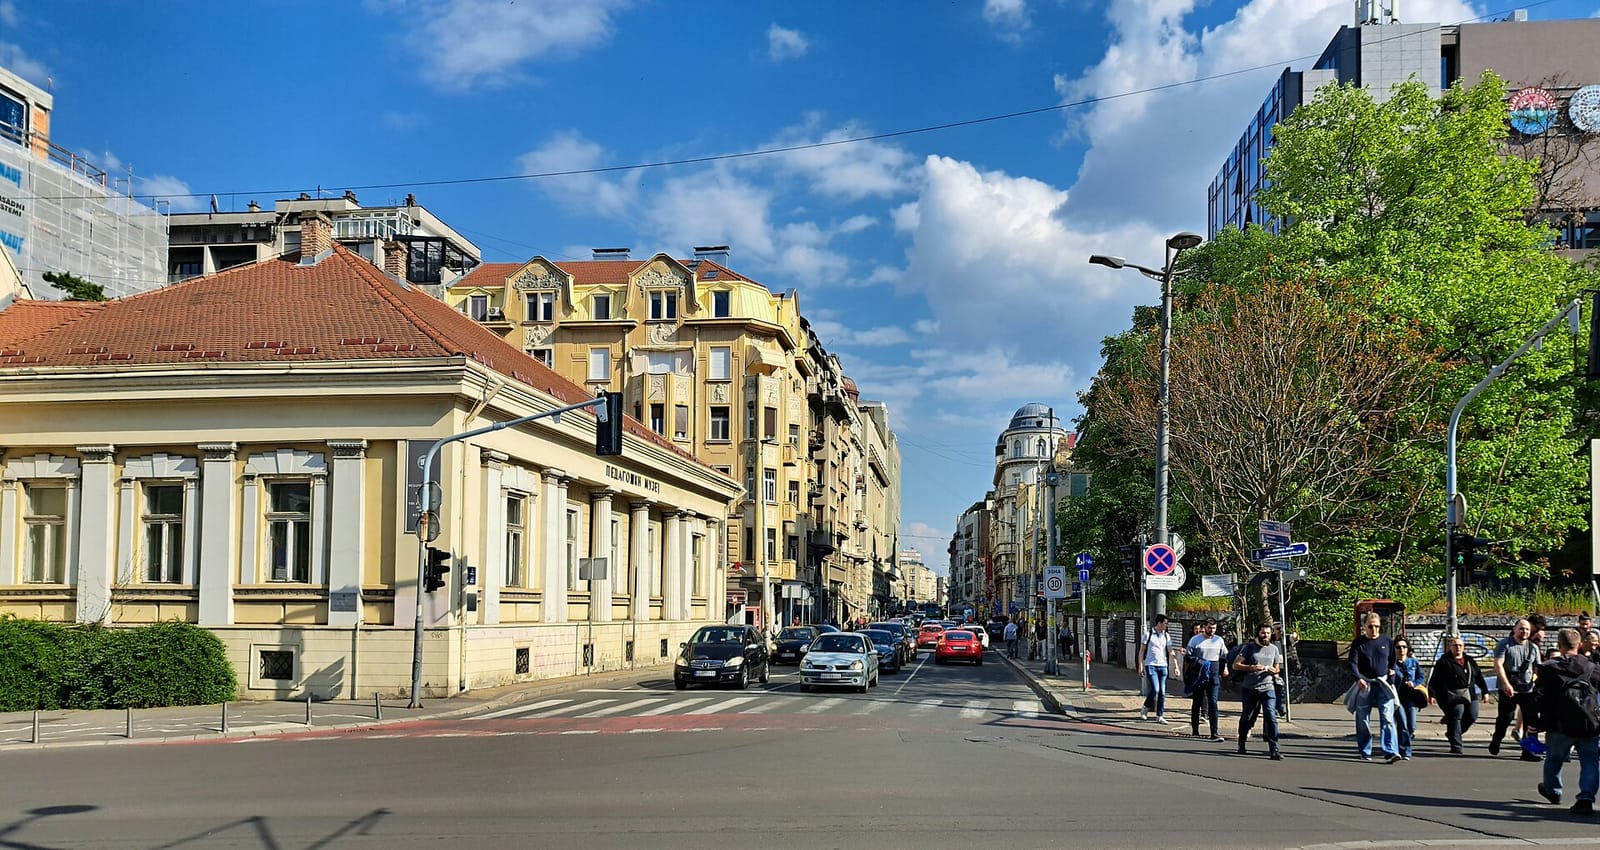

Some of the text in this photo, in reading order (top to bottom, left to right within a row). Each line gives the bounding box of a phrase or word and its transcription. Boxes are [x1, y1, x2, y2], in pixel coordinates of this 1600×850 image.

[0, 196, 25, 211] SADNI
[605, 465, 660, 494] ПЕДАГОШКИ МУЗЕЈ
[1050, 580, 1060, 588] 30
